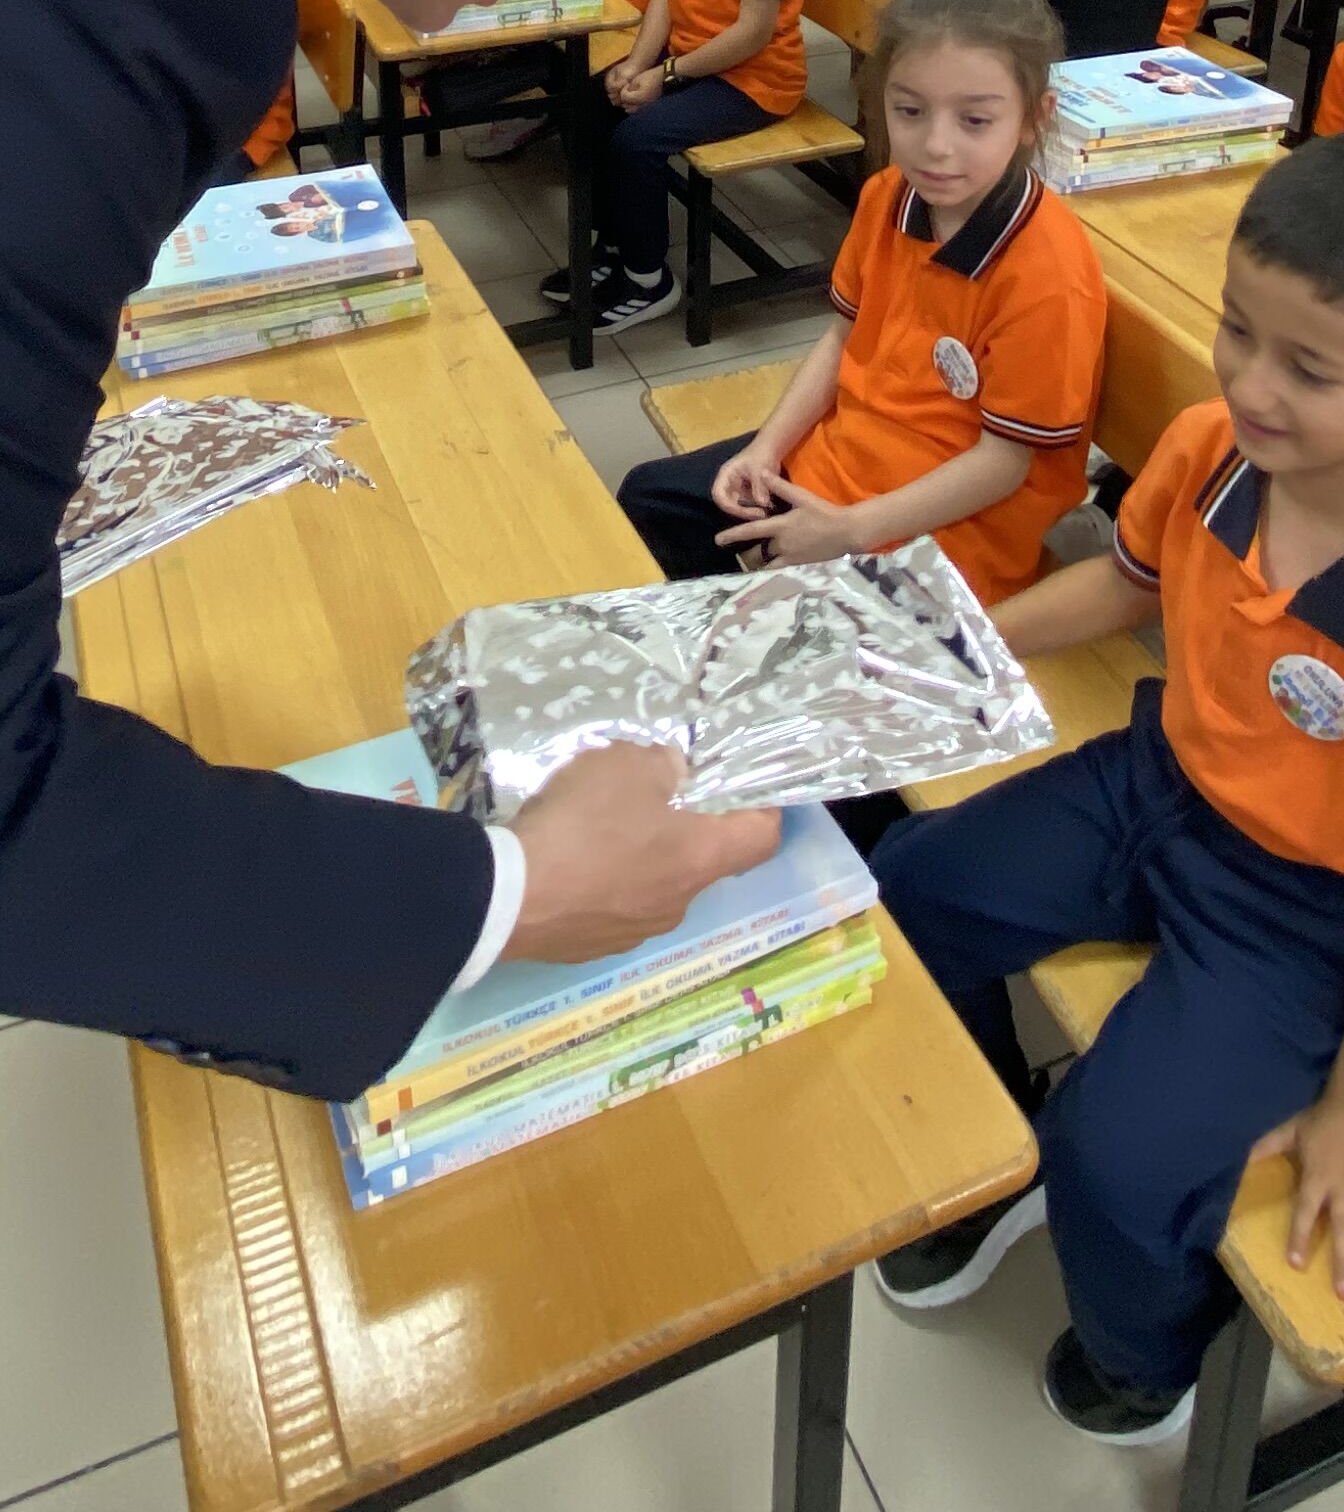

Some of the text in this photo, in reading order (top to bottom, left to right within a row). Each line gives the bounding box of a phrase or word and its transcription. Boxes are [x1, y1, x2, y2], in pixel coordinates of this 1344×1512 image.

[645, 947, 693, 972] OKUMA
[699, 927, 743, 950] YAZMA
[750, 908, 790, 931] KİTABI
[665, 962, 712, 990] OKUMA
[717, 941, 760, 966] YAZMA
[767, 921, 806, 945] KİTABI
